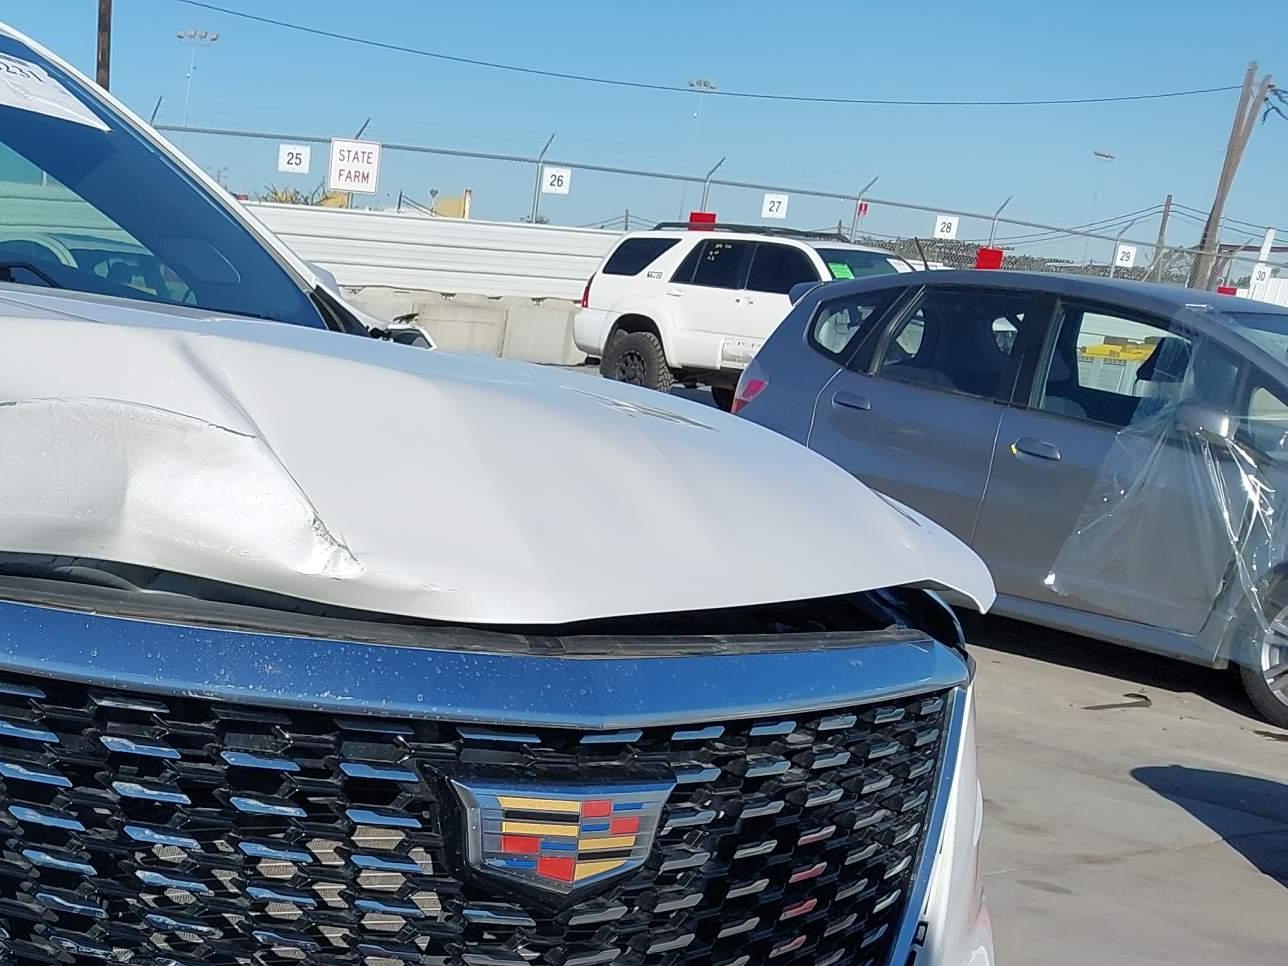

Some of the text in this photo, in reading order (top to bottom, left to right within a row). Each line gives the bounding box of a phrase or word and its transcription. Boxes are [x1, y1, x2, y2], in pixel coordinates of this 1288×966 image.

[286, 151, 302, 166] 25
[338, 149, 373, 164] STATE
[338, 168, 370, 184] FARM
[549, 174, 564, 188] 26
[768, 200, 782, 213] 27
[939, 221, 953, 233] 28
[1119, 250, 1131, 262] 29
[1255, 270, 1266, 281] 30
